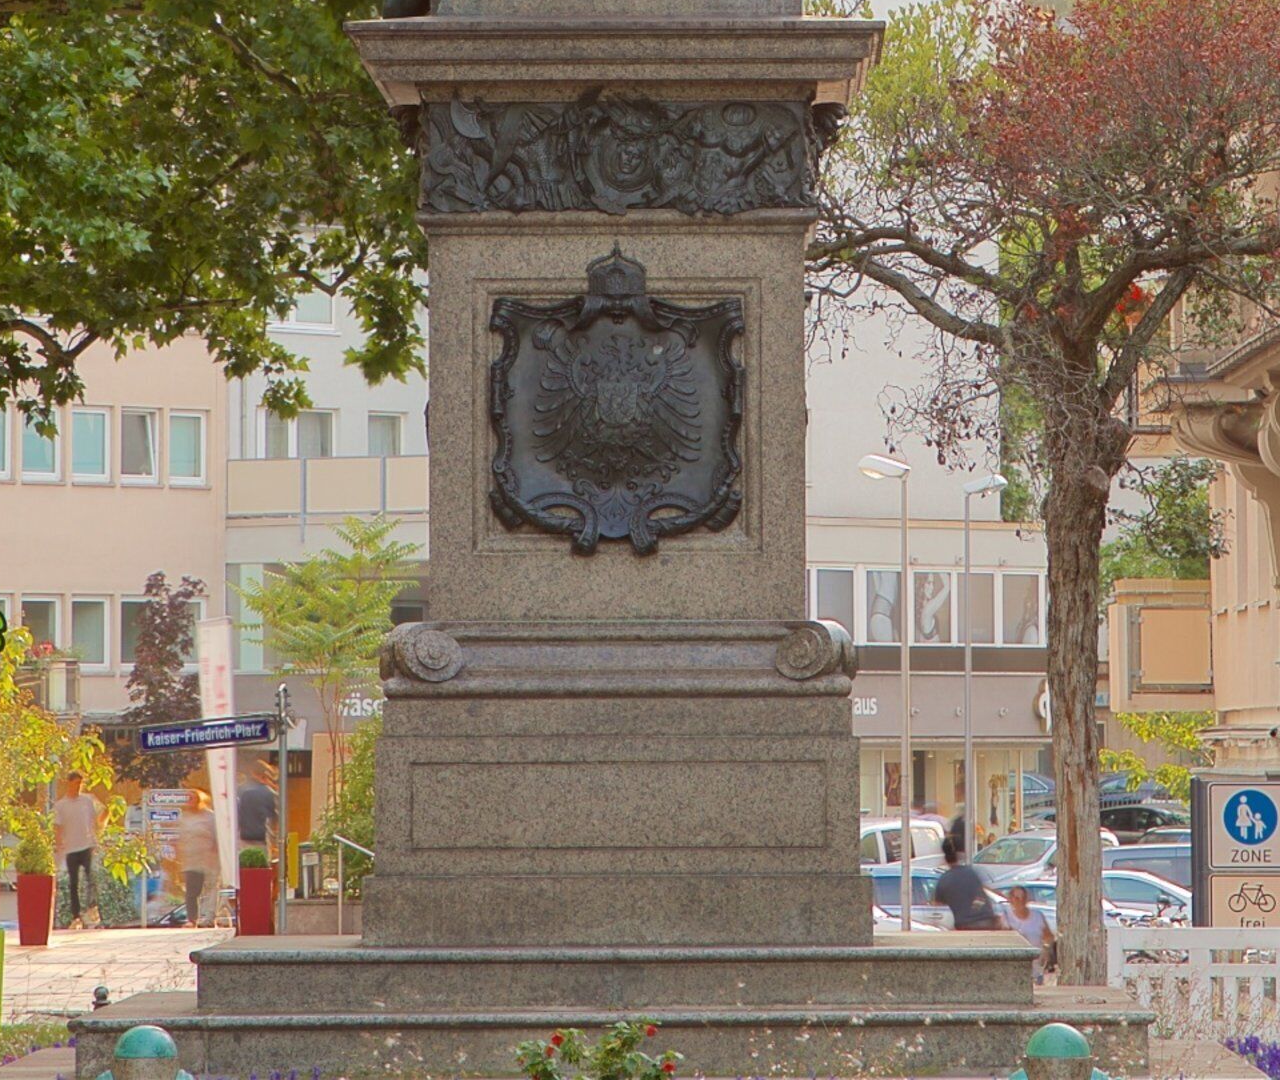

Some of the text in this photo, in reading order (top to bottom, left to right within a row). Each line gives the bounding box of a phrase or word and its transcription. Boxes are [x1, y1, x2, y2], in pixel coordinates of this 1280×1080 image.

[147, 723, 264, 747] Kaiser-Friedrich-Platz
[1231, 849, 1272, 863] ZONE
[1240, 917, 1266, 928] frei
